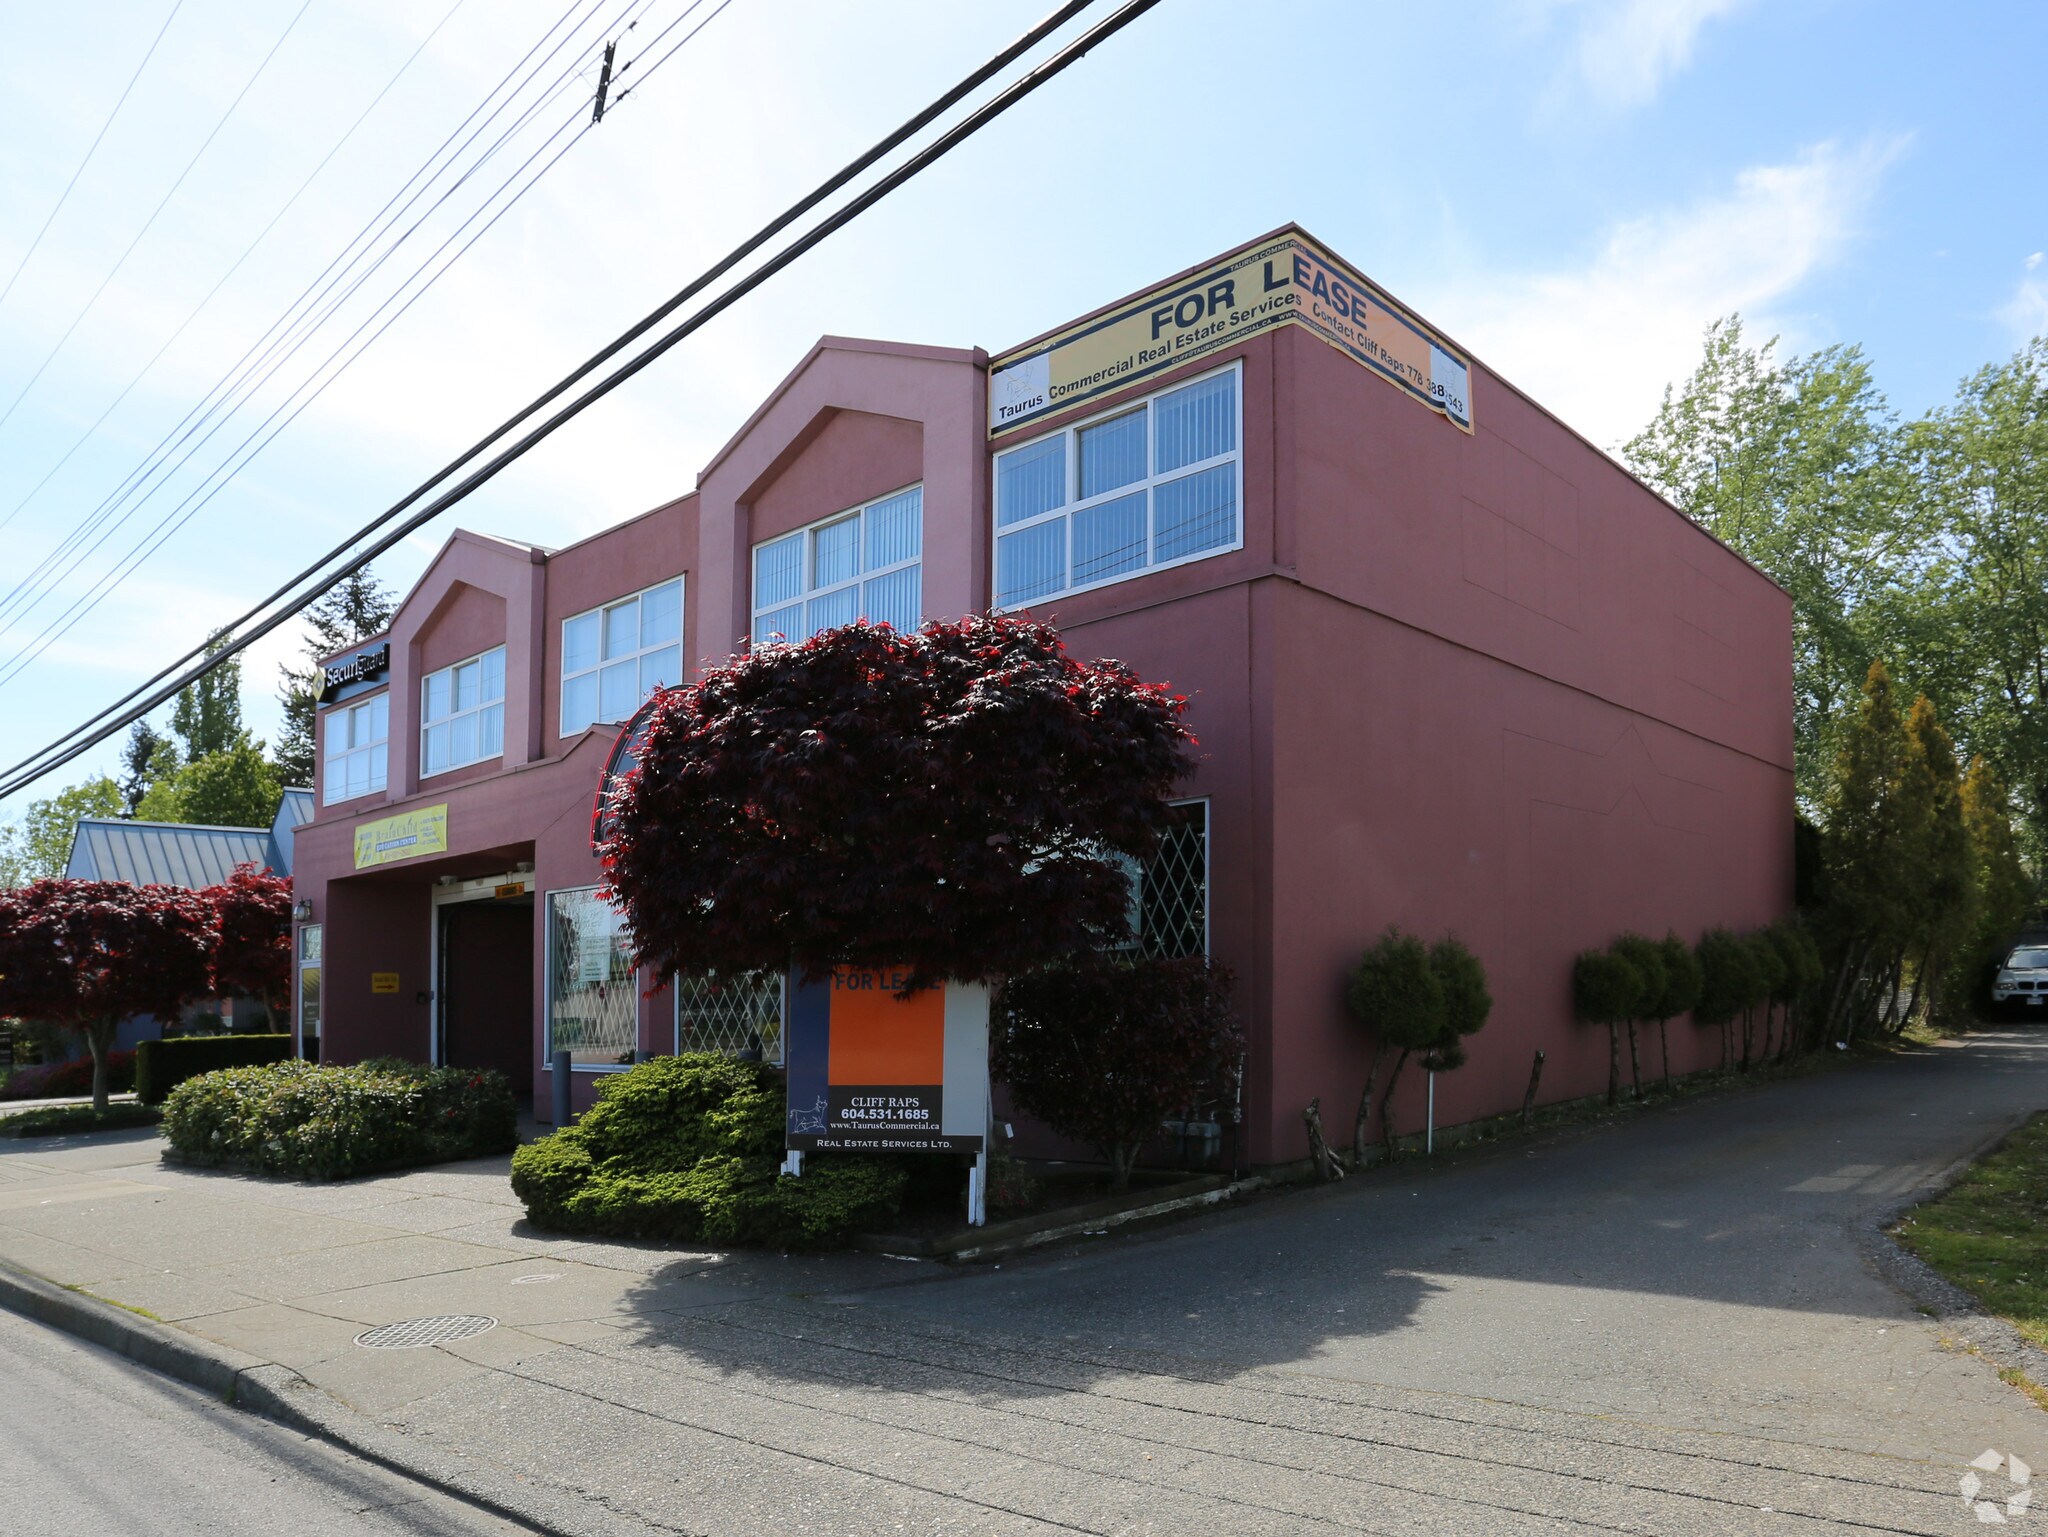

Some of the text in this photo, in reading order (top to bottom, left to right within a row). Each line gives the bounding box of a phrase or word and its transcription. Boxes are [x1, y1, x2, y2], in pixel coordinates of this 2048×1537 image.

[1230, 239, 1308, 272] TAURUS COMMERCIAL
[1151, 252, 1368, 341] FOR LEASE
[1171, 318, 1273, 364] CLIFF@TAURUSCOMMERCIAL.CA
[998, 392, 1044, 420] Taurus
[1048, 354, 1134, 400] Commercial
[1138, 339, 1171, 365] Real
[1175, 321, 1226, 350] Estate
[1229, 292, 1302, 326] Services
[1312, 302, 1355, 342] Contact
[1357, 332, 1378, 356] Cliff
[1380, 347, 1405, 373] Raps
[1407, 364, 1424, 386] 778
[836, 972, 941, 991] FOR LEE
[841, 1108, 929, 1120] 604.531.1685
[851, 1097, 919, 1108] CLIFF RAPS
[830, 1121, 940, 1131] www.TaurusCommercial.ca
